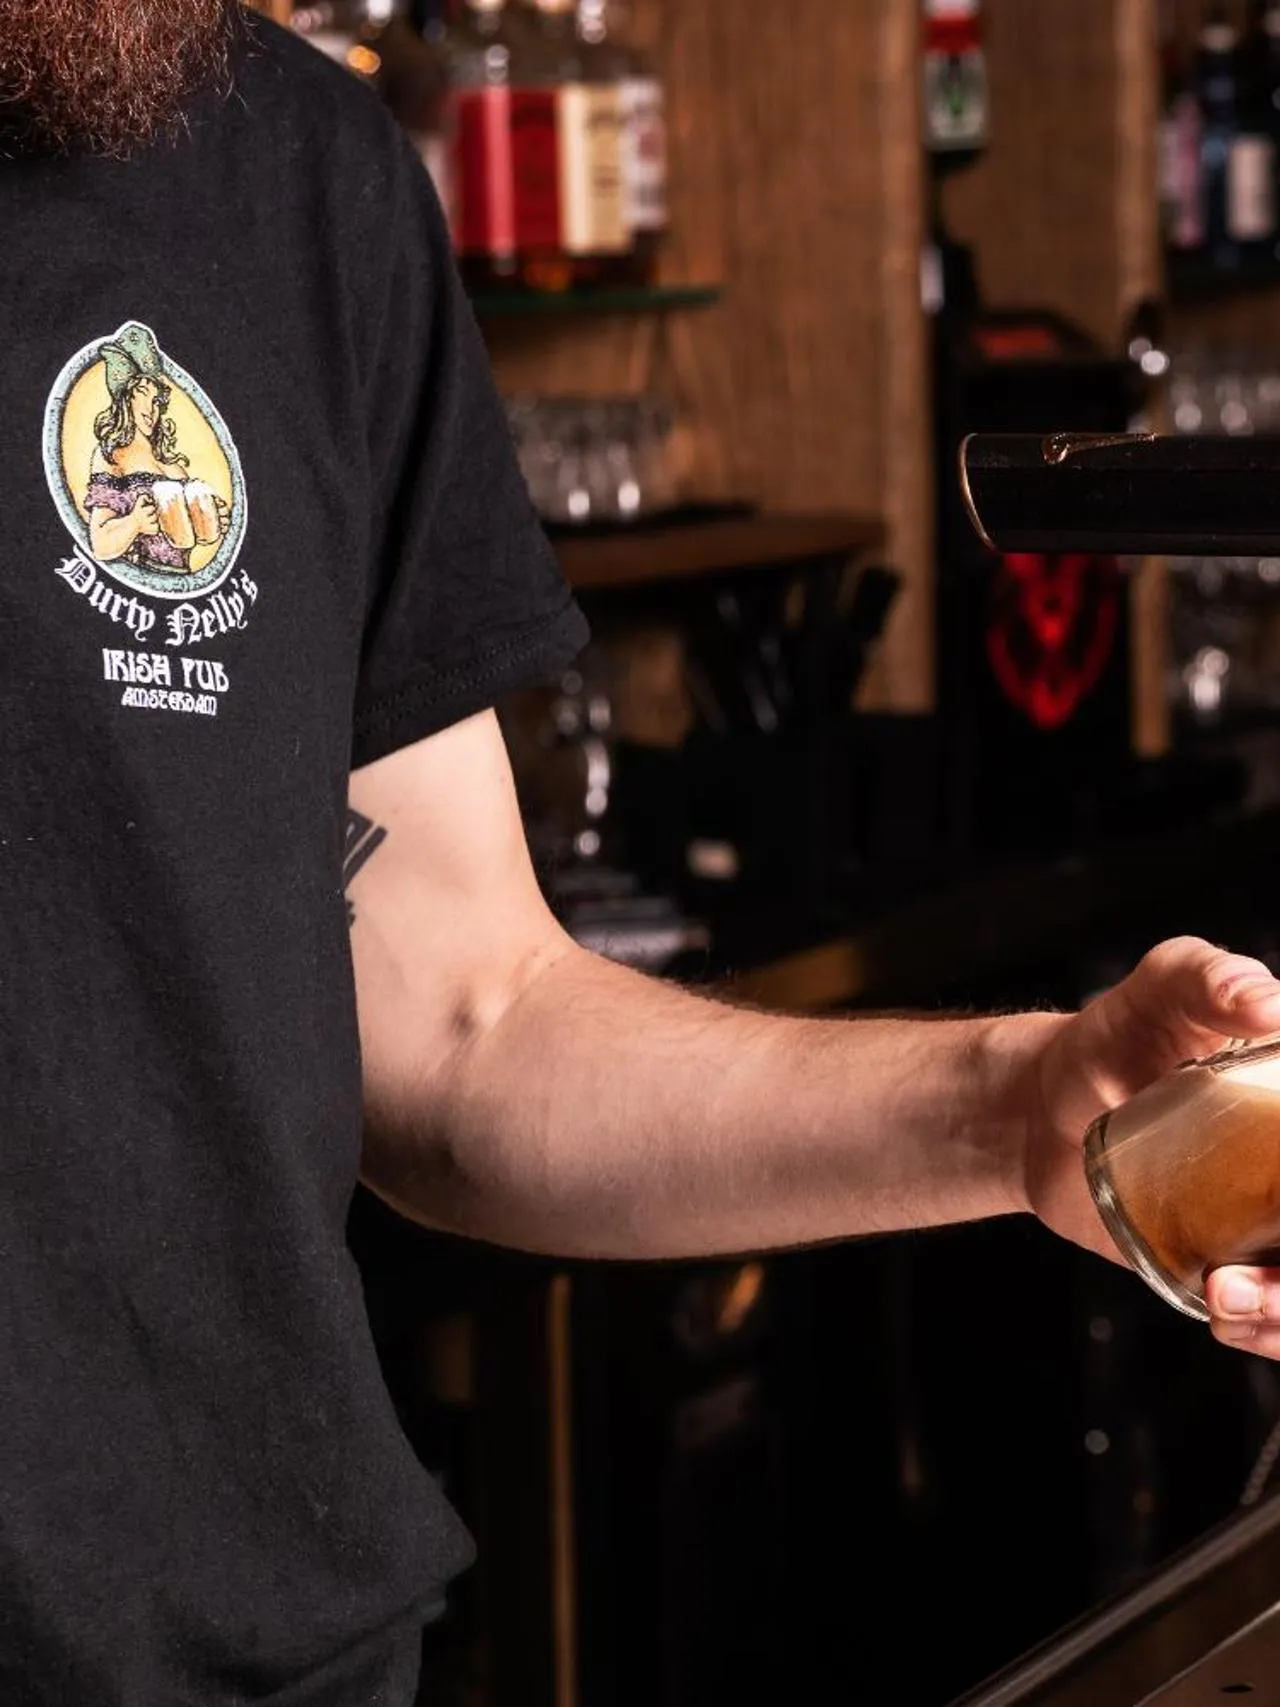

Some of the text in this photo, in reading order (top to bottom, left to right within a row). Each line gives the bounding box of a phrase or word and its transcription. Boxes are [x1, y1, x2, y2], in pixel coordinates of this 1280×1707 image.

[54, 545, 259, 646] Durty Nelly's
[102, 648, 230, 692] IRISH PUB
[121, 686, 218, 716] AMSTERDAM
